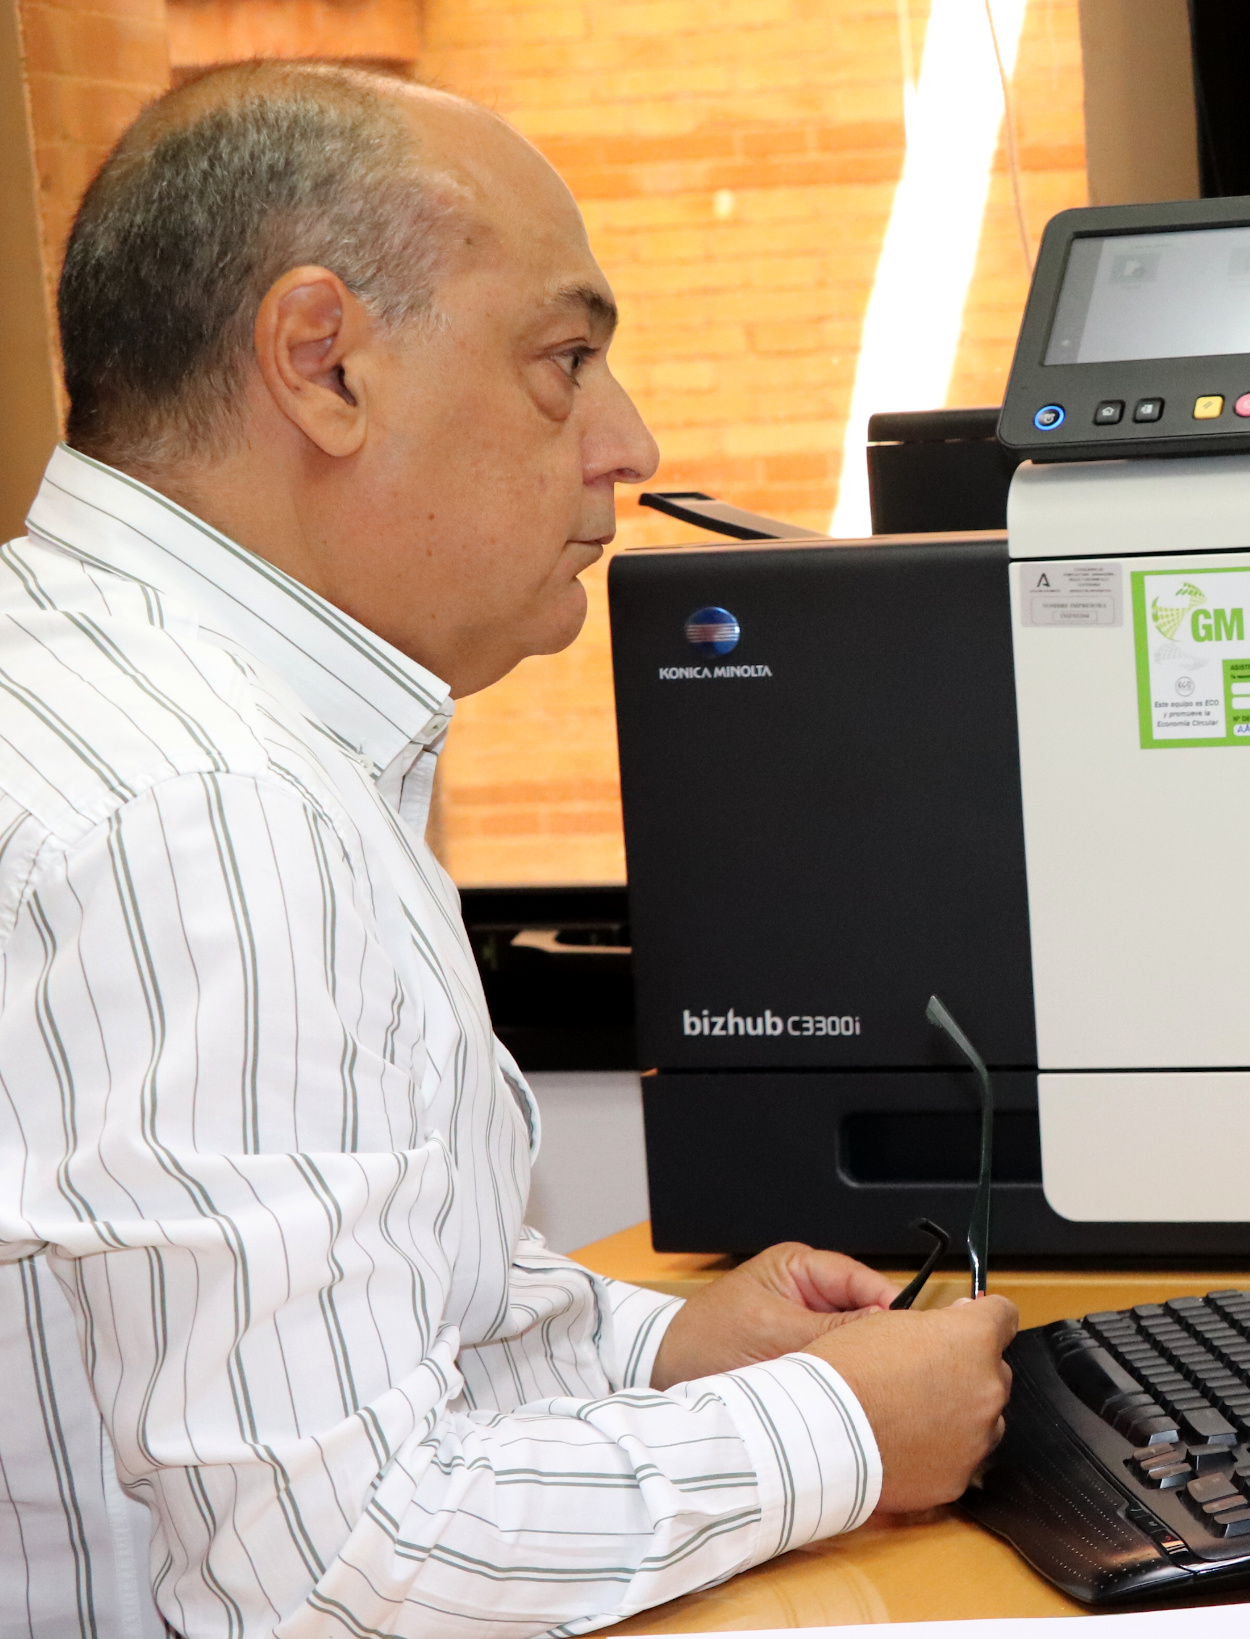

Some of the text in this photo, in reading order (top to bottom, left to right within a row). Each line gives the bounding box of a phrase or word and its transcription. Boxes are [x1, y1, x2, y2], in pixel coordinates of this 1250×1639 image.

[1190, 607, 1244, 643] GM
[659, 664, 773, 680] KONICA MINOLTA
[683, 1007, 861, 1036] bizhub C3300i
